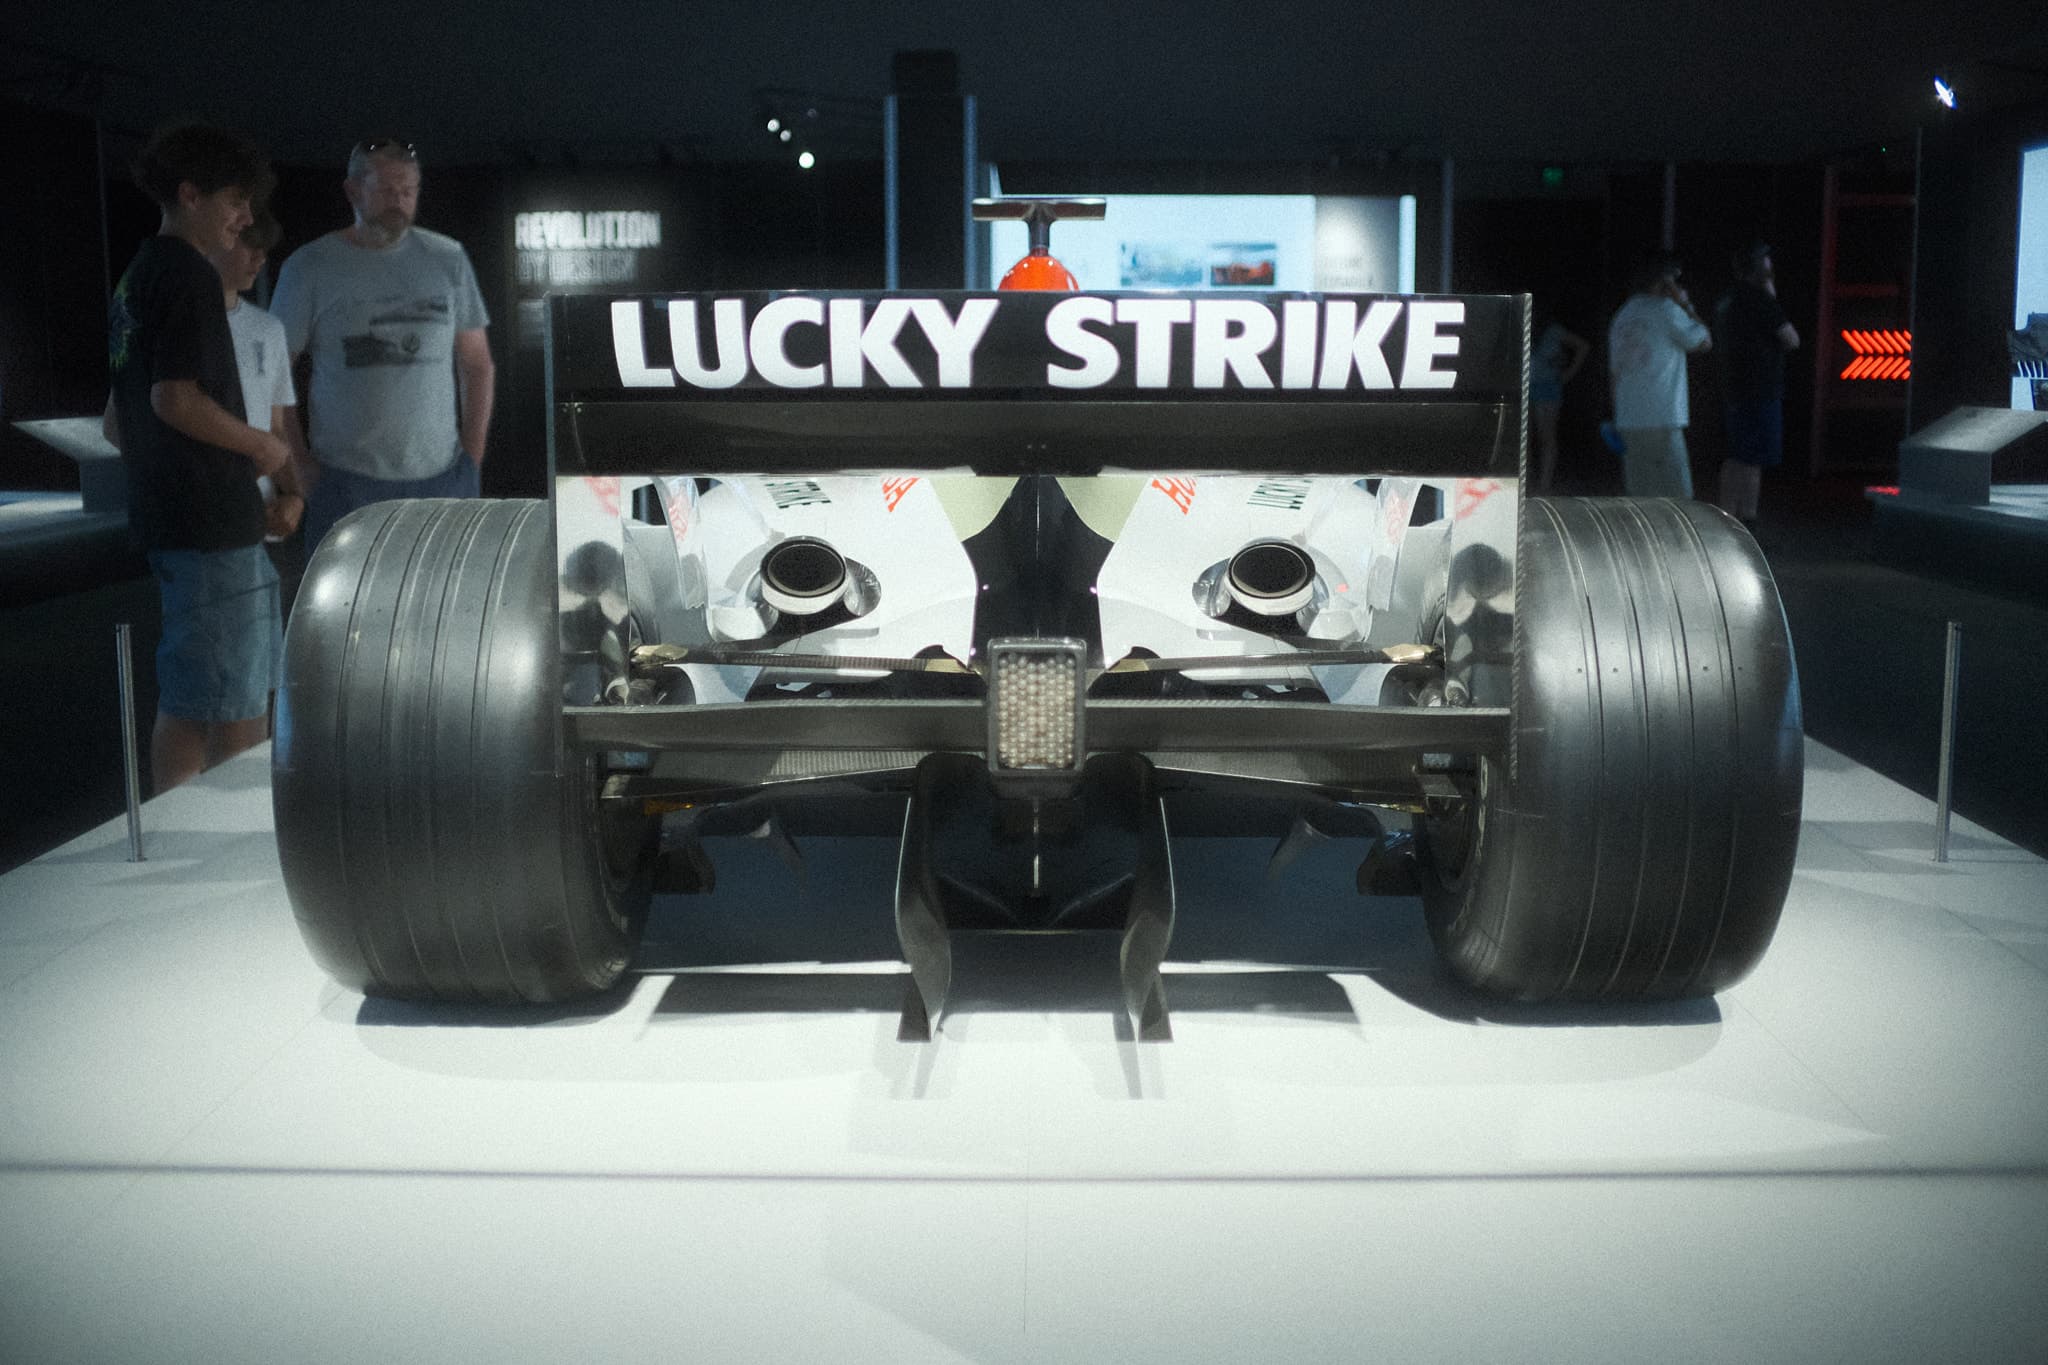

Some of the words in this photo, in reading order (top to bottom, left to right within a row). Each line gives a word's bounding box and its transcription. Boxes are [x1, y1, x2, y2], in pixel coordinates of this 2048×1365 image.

[515, 211, 661, 249] REVOLUTION
[611, 297, 998, 388] LUCKY
[1045, 296, 1465, 389] STRIKE
